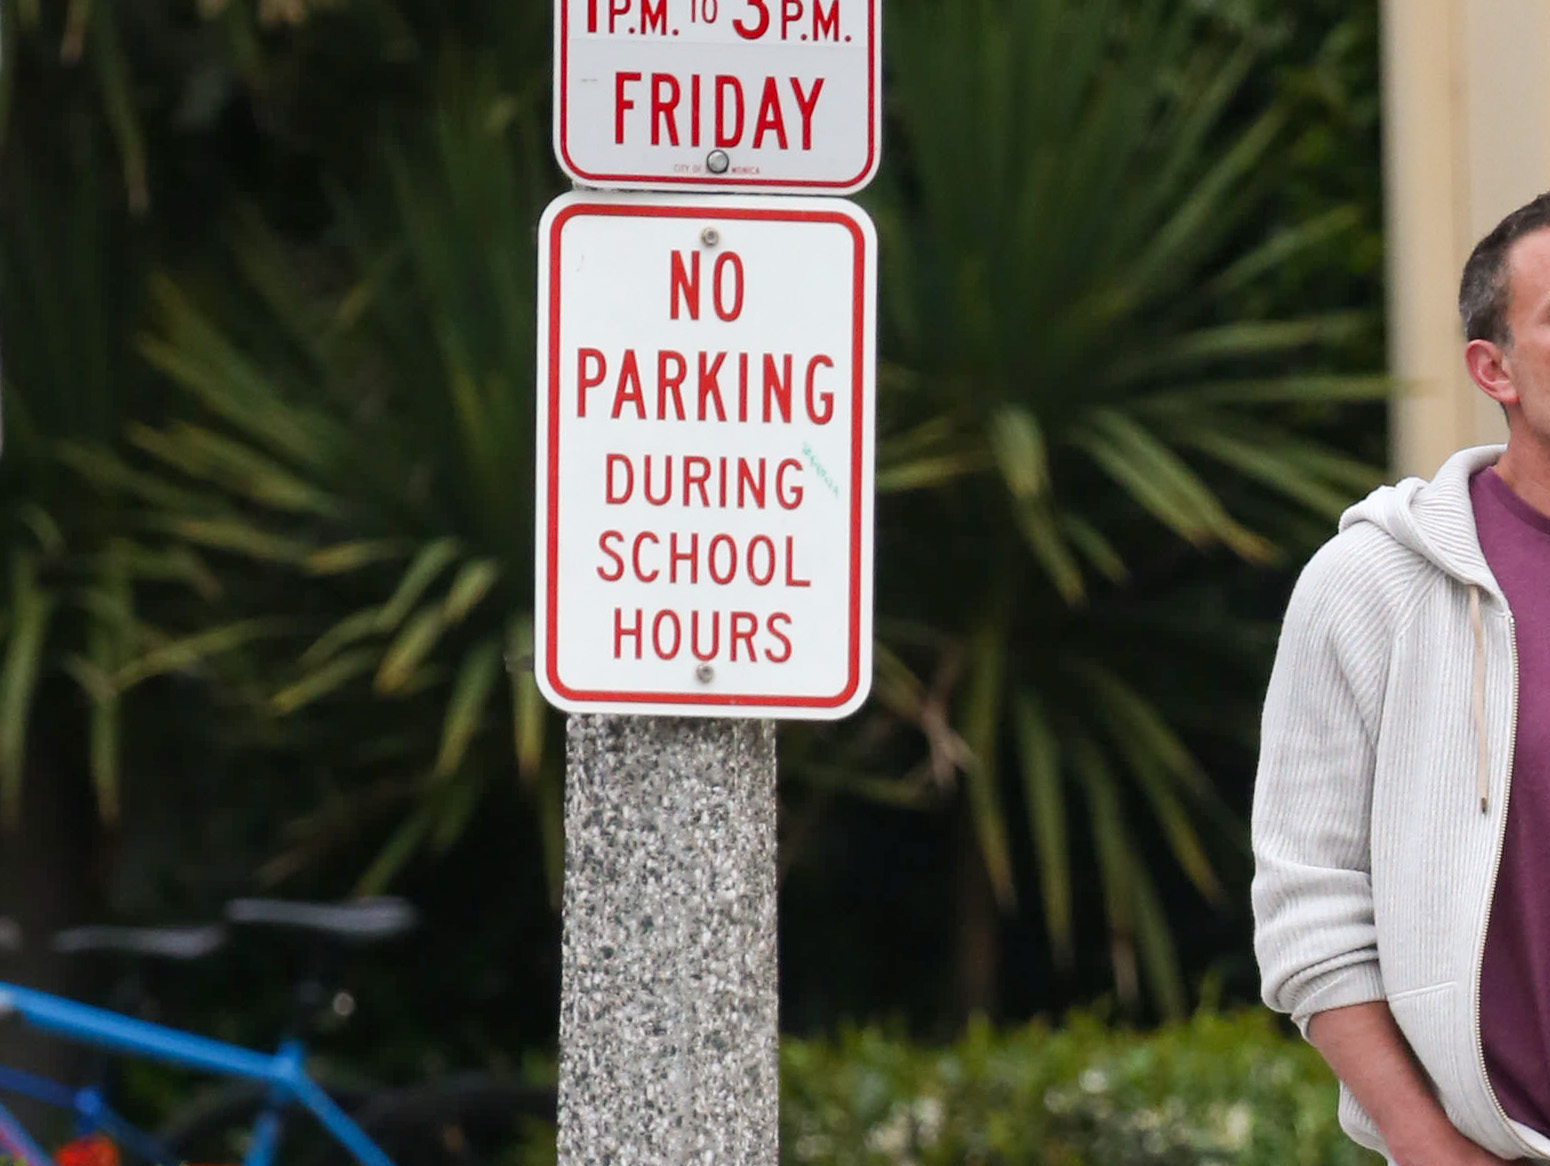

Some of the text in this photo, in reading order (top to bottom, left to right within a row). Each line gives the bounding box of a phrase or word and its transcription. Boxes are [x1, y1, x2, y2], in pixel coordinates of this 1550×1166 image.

[780, 0, 851, 42] P.M.
[614, 71, 825, 150] FRIDAY
[669, 249, 744, 322] NO
[576, 347, 834, 425] PARKING
[605, 453, 804, 510] DURING
[596, 530, 811, 587] SCHOOL
[613, 608, 793, 663] HOURS
